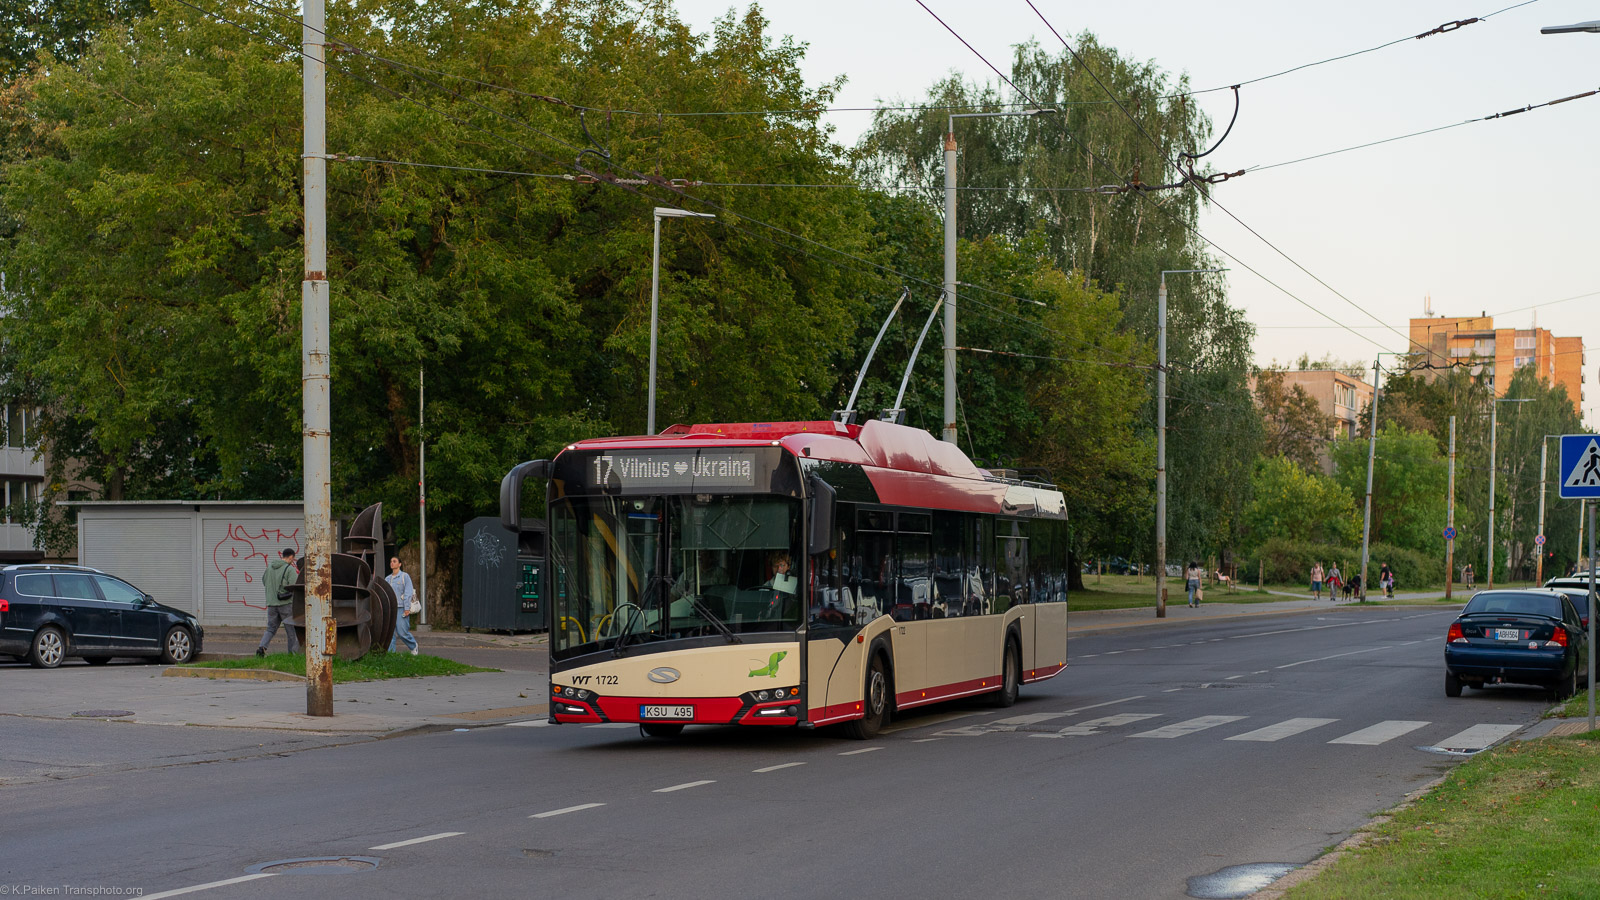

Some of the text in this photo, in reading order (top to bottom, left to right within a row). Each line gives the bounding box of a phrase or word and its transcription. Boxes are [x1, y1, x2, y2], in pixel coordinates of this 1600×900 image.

[593, 455, 752, 485] 17 Vilnius Ukrainą
[571, 675, 619, 685] VVT 1722
[646, 706, 668, 717] KSU
[674, 706, 692, 717] 495
